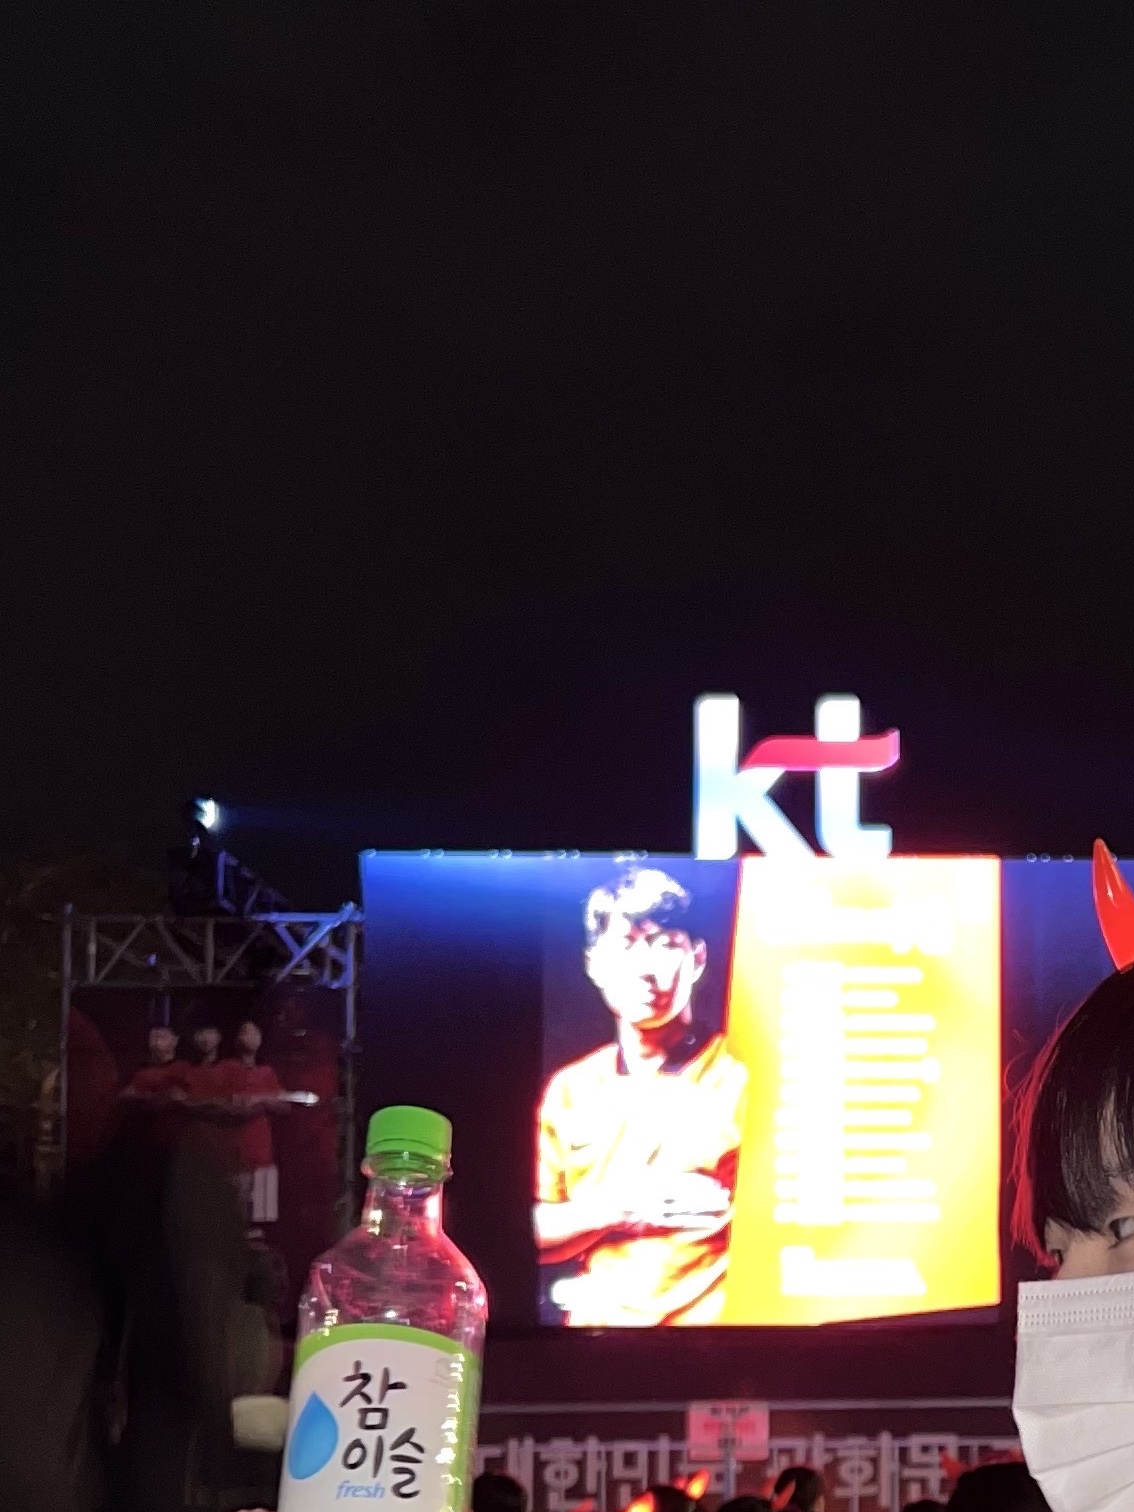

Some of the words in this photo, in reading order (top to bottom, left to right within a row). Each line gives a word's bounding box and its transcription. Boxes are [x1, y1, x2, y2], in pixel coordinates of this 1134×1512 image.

[693, 692, 901, 860] kt
[339, 1360, 408, 1430] 참
[336, 1480, 386, 1501] fresh
[342, 1427, 425, 1499] 이슬
